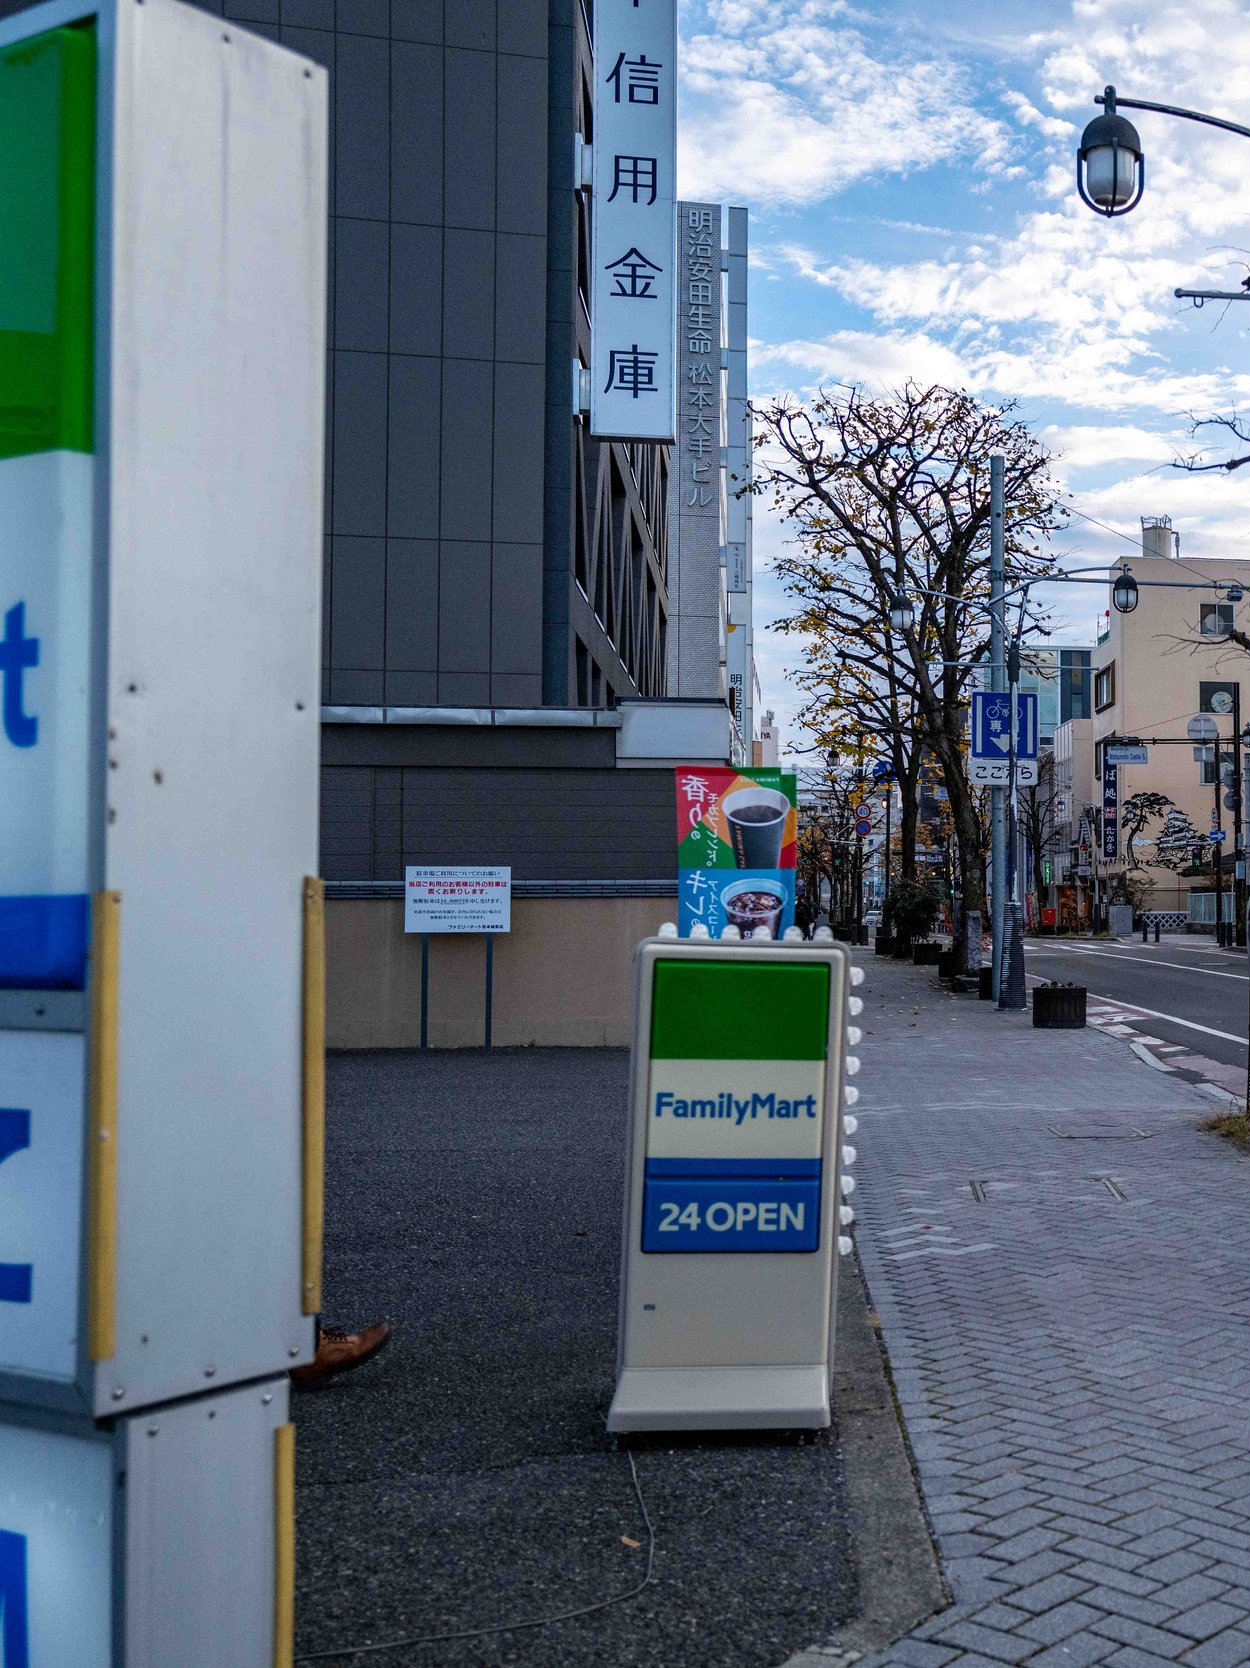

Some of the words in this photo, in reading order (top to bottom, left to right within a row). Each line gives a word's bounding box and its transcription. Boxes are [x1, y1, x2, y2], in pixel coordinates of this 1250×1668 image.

[603, 0, 663, 399] 信用金庫
[688, 209, 713, 354] 明治安田生命
[688, 362, 713, 507] 松本大手ビル
[1104, 756, 1117, 800] ば処
[859, 807, 869, 815] 40
[655, 1092, 816, 1125] FamilyMart
[658, 1202, 701, 1232] 24
[706, 1201, 805, 1232] OPEN
